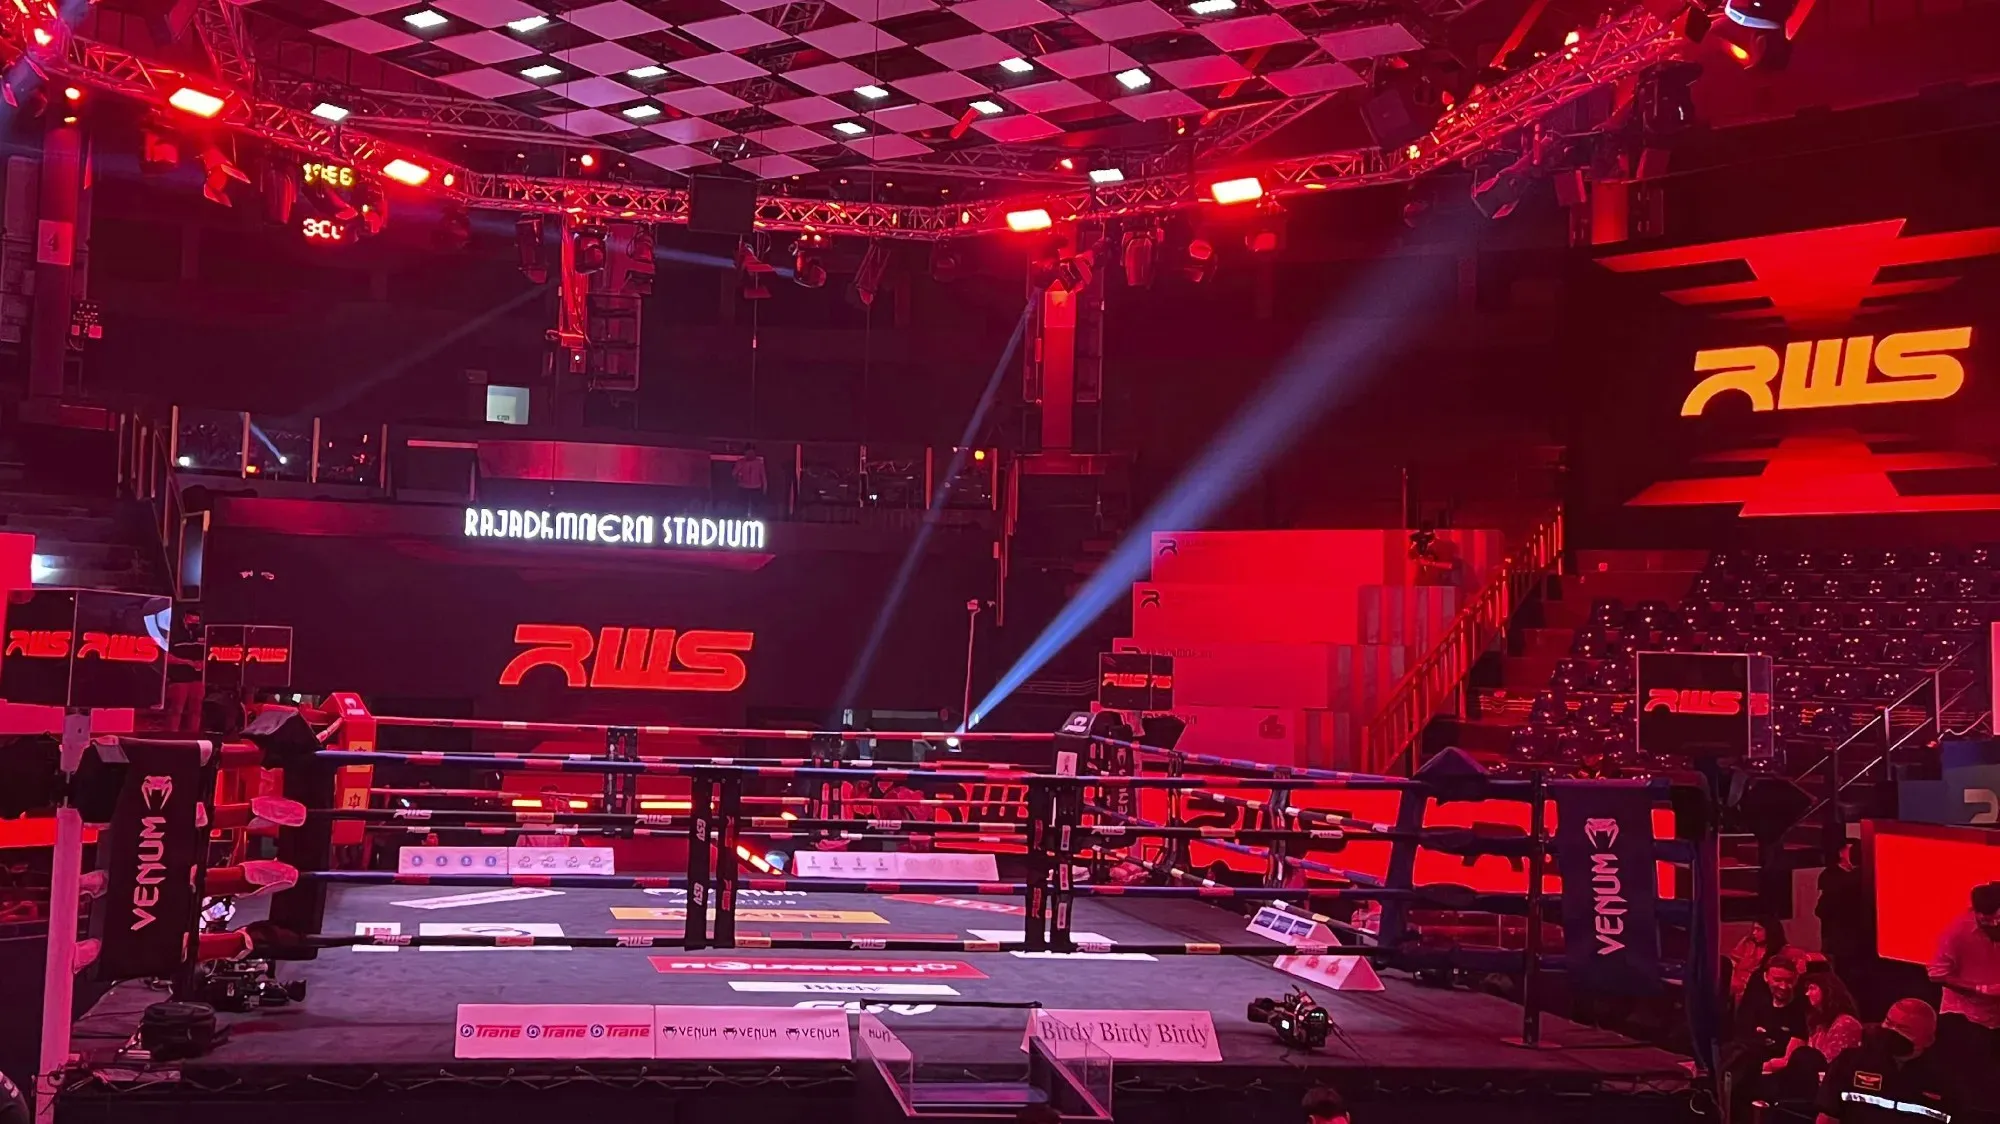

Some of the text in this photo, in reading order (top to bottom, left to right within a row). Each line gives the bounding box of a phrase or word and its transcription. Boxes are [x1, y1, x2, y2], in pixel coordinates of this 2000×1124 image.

[1681, 326, 1972, 416] RWS
[662, 515, 765, 549] STADIUM
[5, 630, 72, 657] RWS
[77, 632, 160, 662] RWS
[207, 646, 244, 661] RWS
[245, 647, 289, 662] RWS
[499, 623, 754, 692] RWS
[1102, 672, 1149, 688] RWS
[1644, 688, 1743, 715] RWS
[393, 809, 433, 819] RWS
[635, 815, 673, 825] RWS
[867, 820, 902, 830] RWS
[130, 816, 167, 931] VENUM
[1590, 853, 1628, 955] VENUM
[373, 935, 412, 946] RWS
[616, 936, 654, 947] RWS
[850, 939, 887, 949] RWS
[475, 1023, 651, 1039] Trane Trane Trane
[679, 1025, 840, 1042] VENUM VENUM VENUM
[1040, 1020, 1209, 1048] Birdy Birdy Birdy
